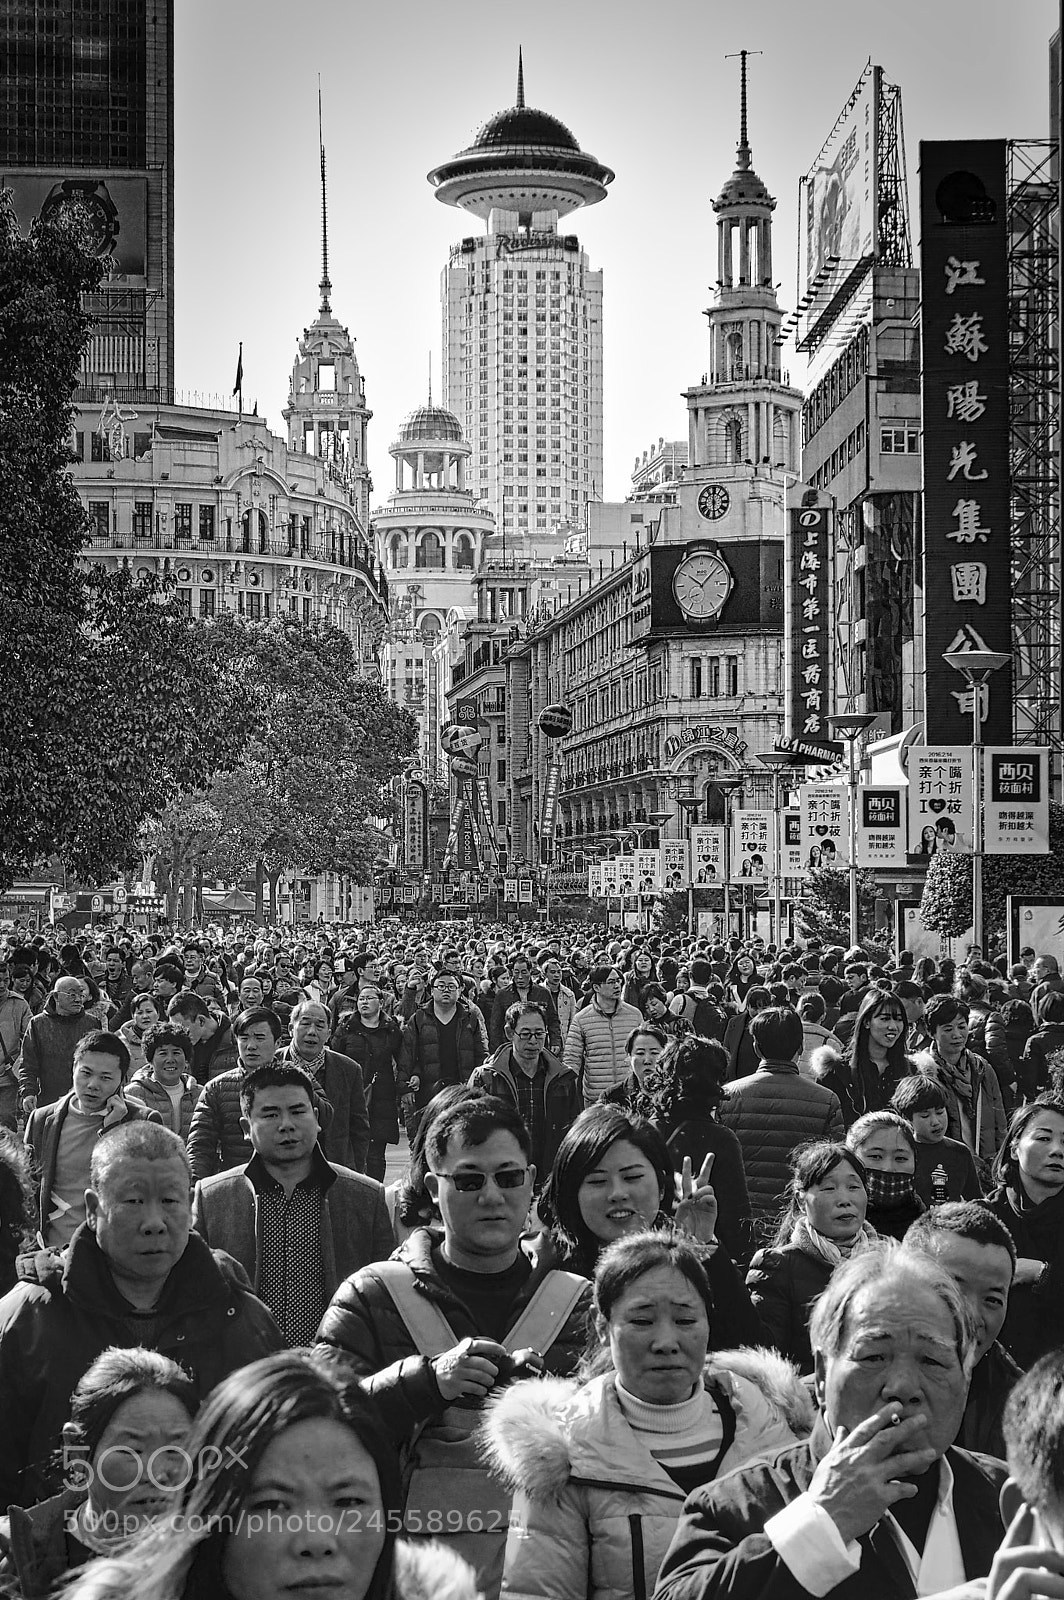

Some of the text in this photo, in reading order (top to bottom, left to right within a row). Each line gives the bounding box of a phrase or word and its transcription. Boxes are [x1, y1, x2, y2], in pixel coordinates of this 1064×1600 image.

[799, 530, 821, 734] 上海市第一医药商店
[681, 725, 740, 749] 锦江之星
[773, 733, 799, 752] NO.1
[919, 766, 962, 779] 亲个嘴
[999, 763, 1034, 780] 西贝
[919, 781, 962, 794] 打个折
[999, 782, 1033, 794] 莜面村
[808, 800, 841, 810] 亲个嘴
[868, 798, 895, 811] 西贝
[920, 800, 928, 813] I
[808, 811, 841, 822] 打个折
[808, 826, 815, 836] I
[998, 822, 1034, 830] 折扣越大
[741, 832, 767, 840] 打个折
[741, 843, 747, 851] I
